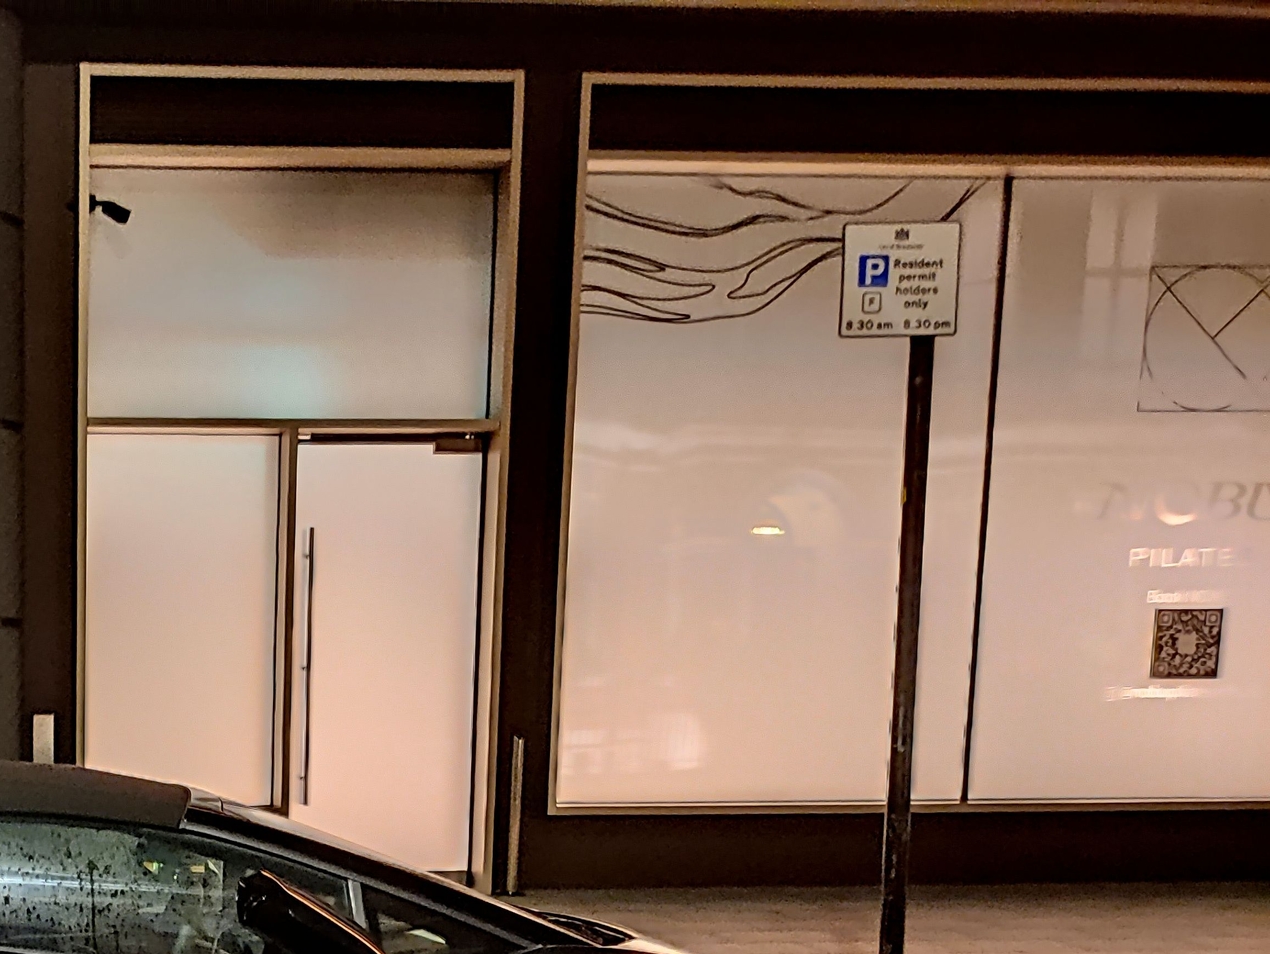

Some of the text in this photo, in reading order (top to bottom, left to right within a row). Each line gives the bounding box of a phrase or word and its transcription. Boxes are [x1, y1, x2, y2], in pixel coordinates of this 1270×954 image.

[893, 258, 944, 269] Resident
[898, 272, 936, 284] permit
[895, 285, 938, 296] holders
[903, 298, 928, 310] only
[876, 320, 893, 330] am
[933, 319, 951, 330] pm
